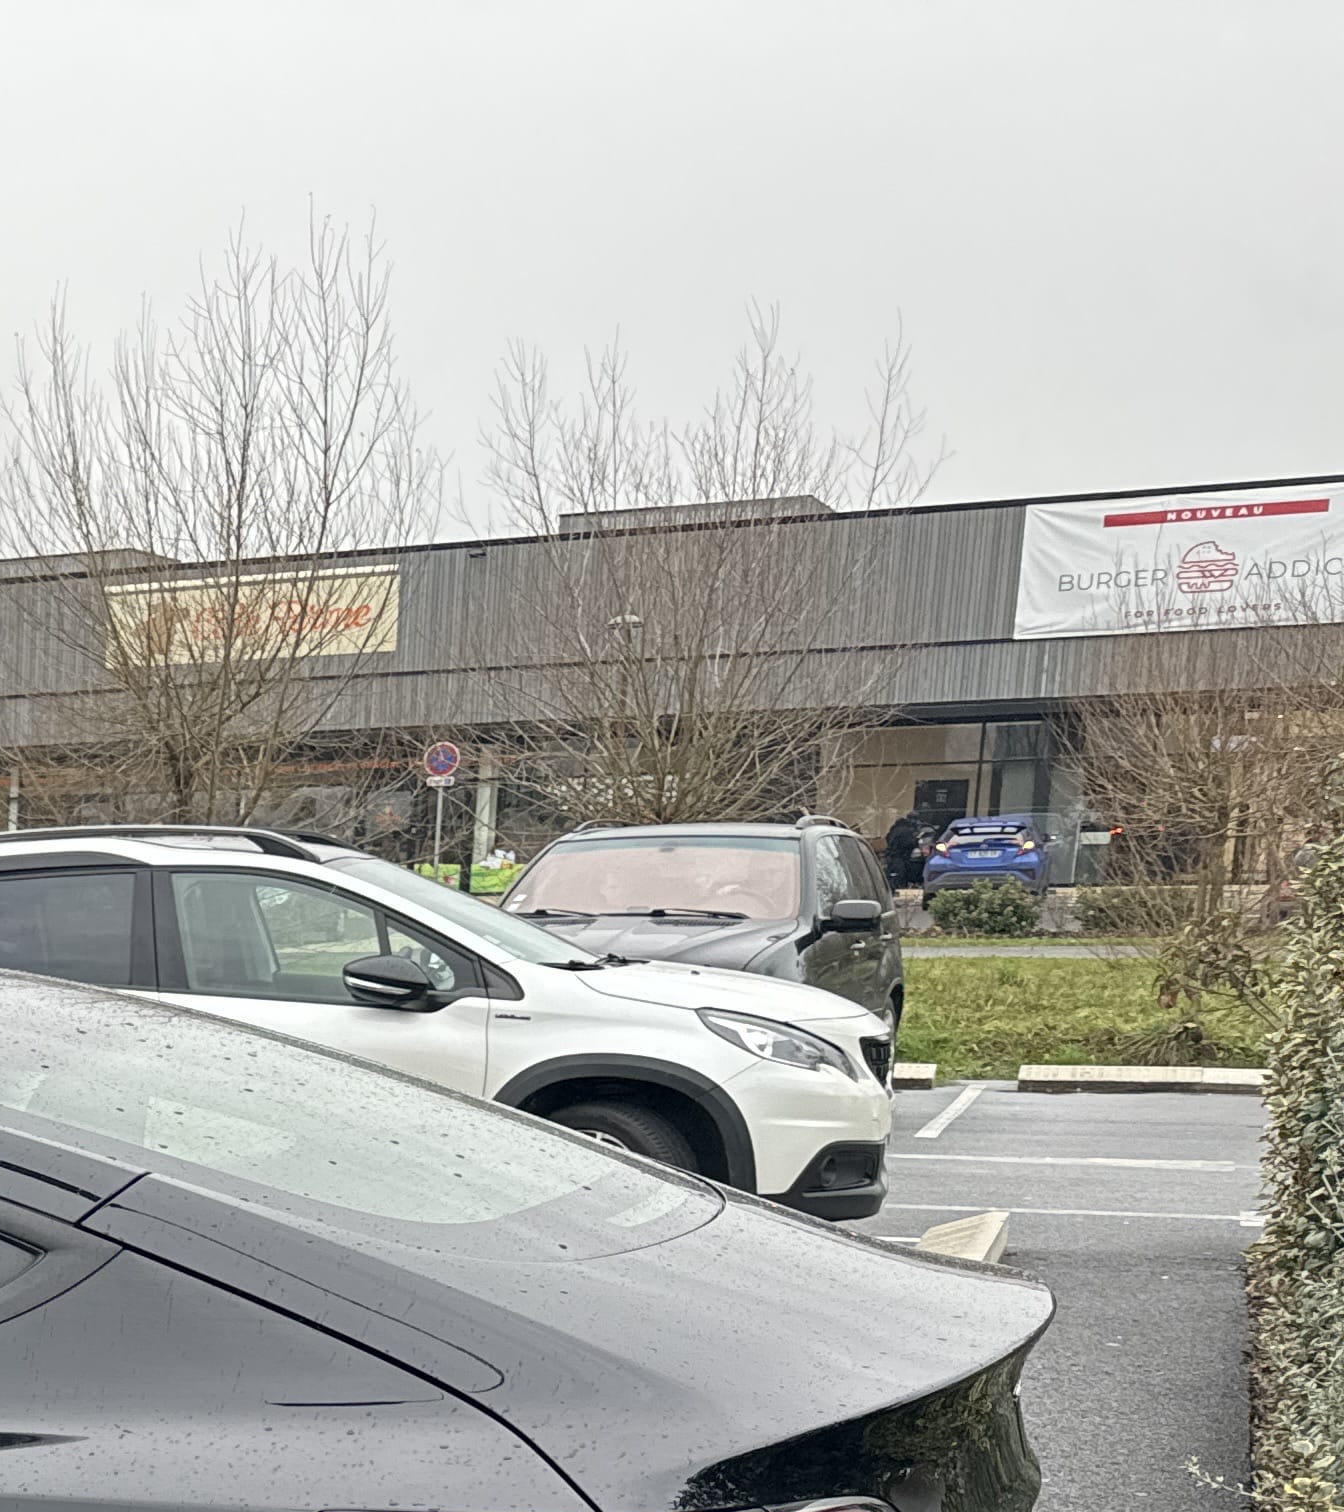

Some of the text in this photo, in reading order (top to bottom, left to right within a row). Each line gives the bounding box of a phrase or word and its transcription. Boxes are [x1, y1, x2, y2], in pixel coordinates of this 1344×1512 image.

[1166, 506, 1263, 521] NOUVEAU
[1058, 557, 1343, 592] BURGER ADDIC
[1124, 602, 1283, 619] FOR FOOD LOVERS
